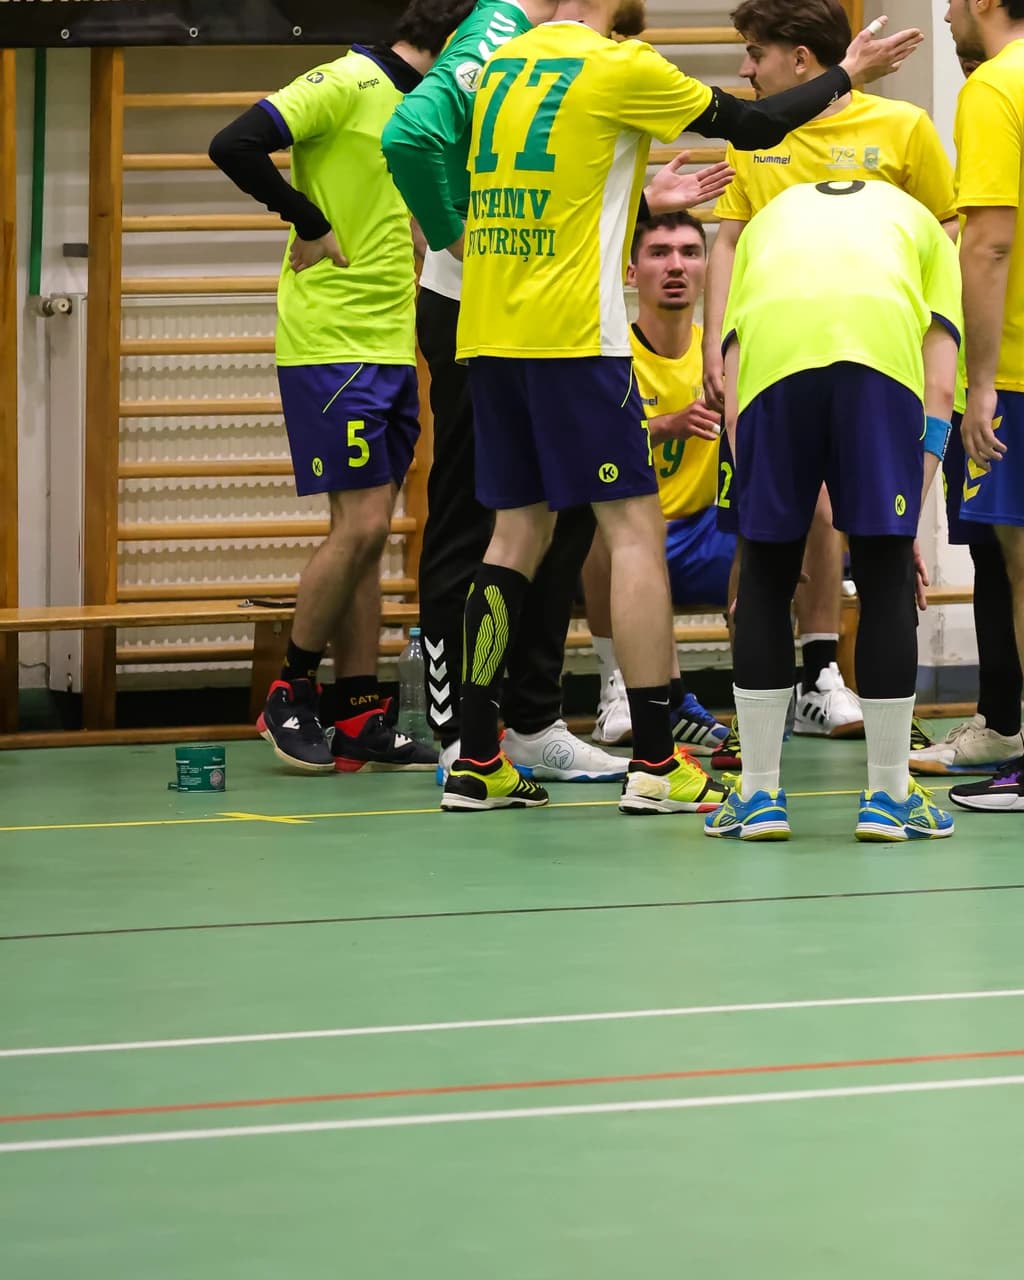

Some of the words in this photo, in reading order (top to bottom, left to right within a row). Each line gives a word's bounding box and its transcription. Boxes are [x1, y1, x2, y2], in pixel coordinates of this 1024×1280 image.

[358, 78, 380, 90] Kempa
[475, 58, 585, 174] 77
[753, 154, 791, 164] hummel
[471, 188, 551, 220] USAMV
[347, 420, 370, 468] 5
